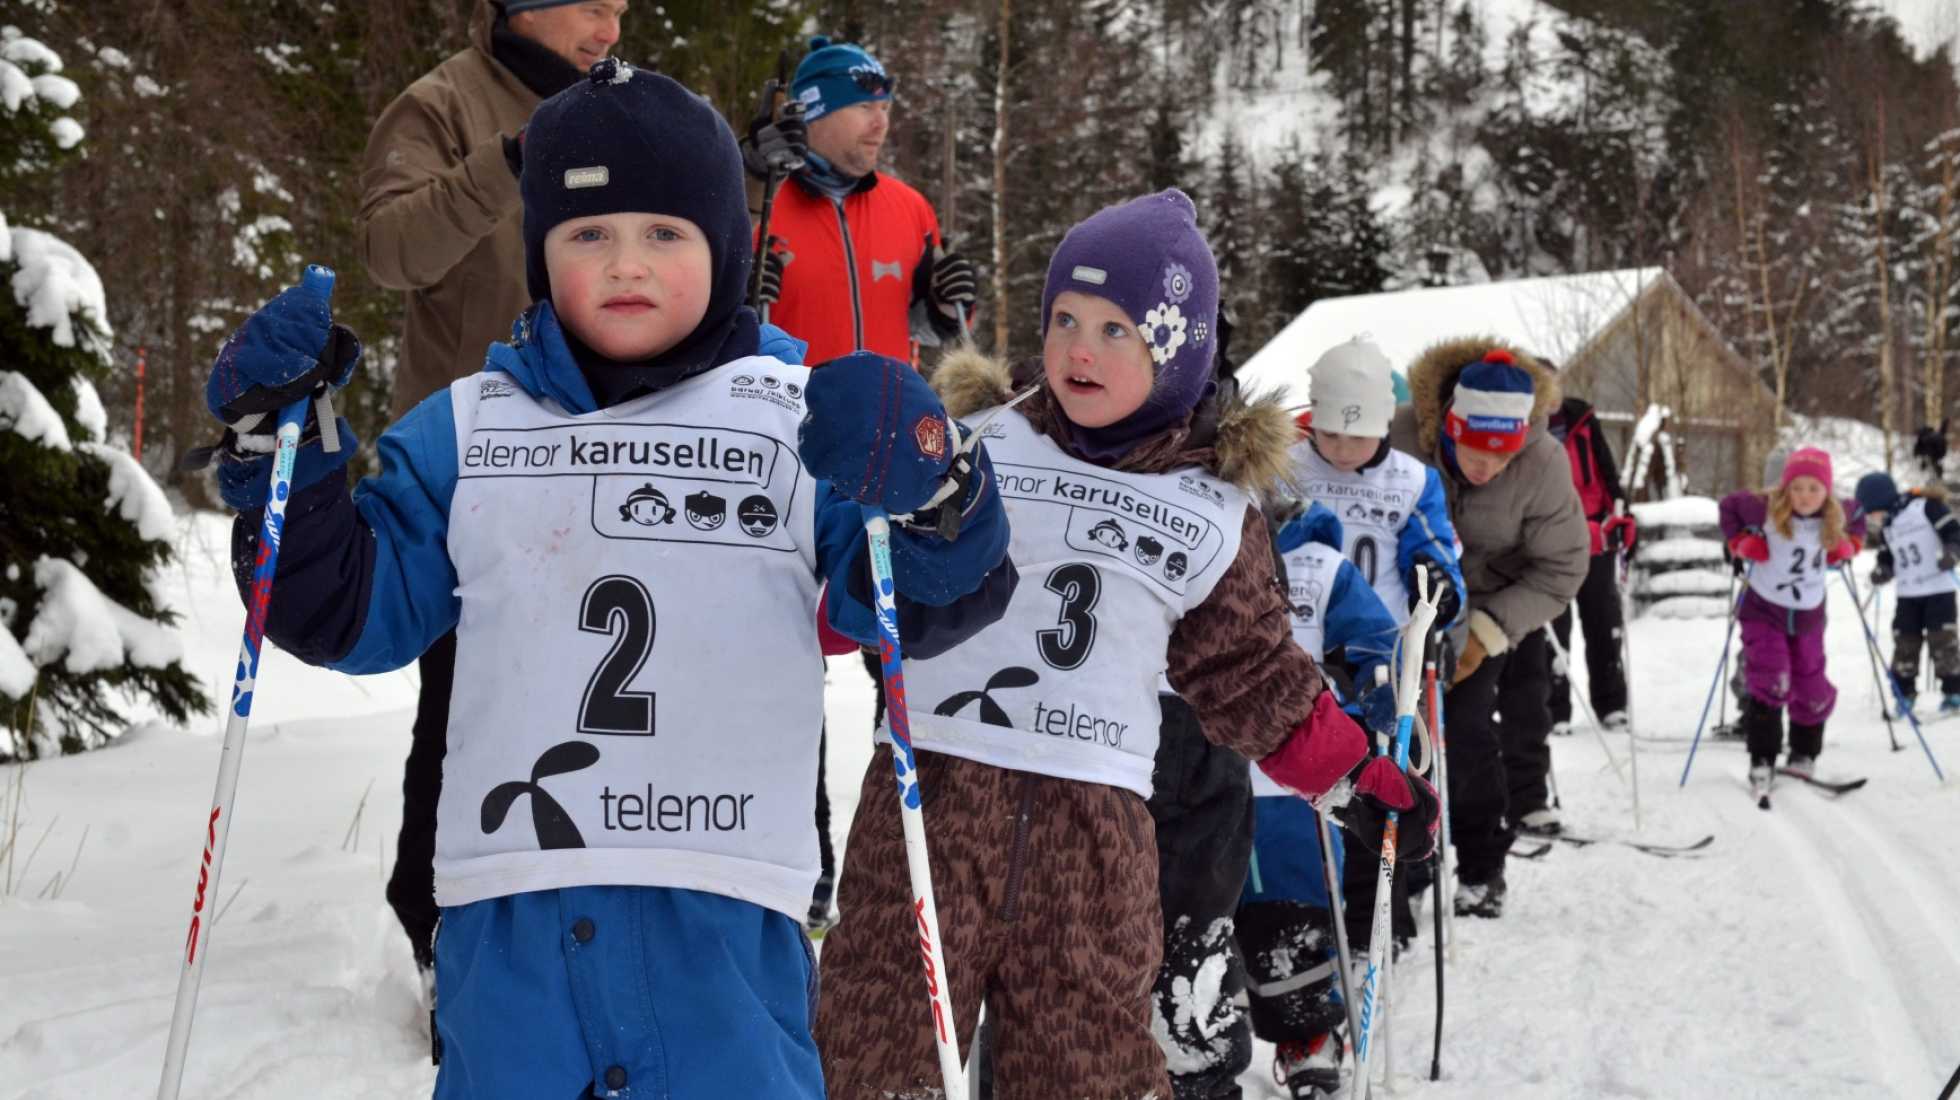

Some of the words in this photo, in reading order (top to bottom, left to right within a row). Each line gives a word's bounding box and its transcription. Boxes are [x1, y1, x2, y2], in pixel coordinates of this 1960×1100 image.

[464, 438, 561, 468] elenor
[570, 435, 764, 478] karusellen
[996, 473, 1046, 494] enor
[1053, 475, 1201, 542] karusellen
[1036, 562, 1102, 672] 3
[576, 574, 657, 737] 2
[1034, 701, 1129, 748] telenor
[600, 783, 754, 832] telenor
